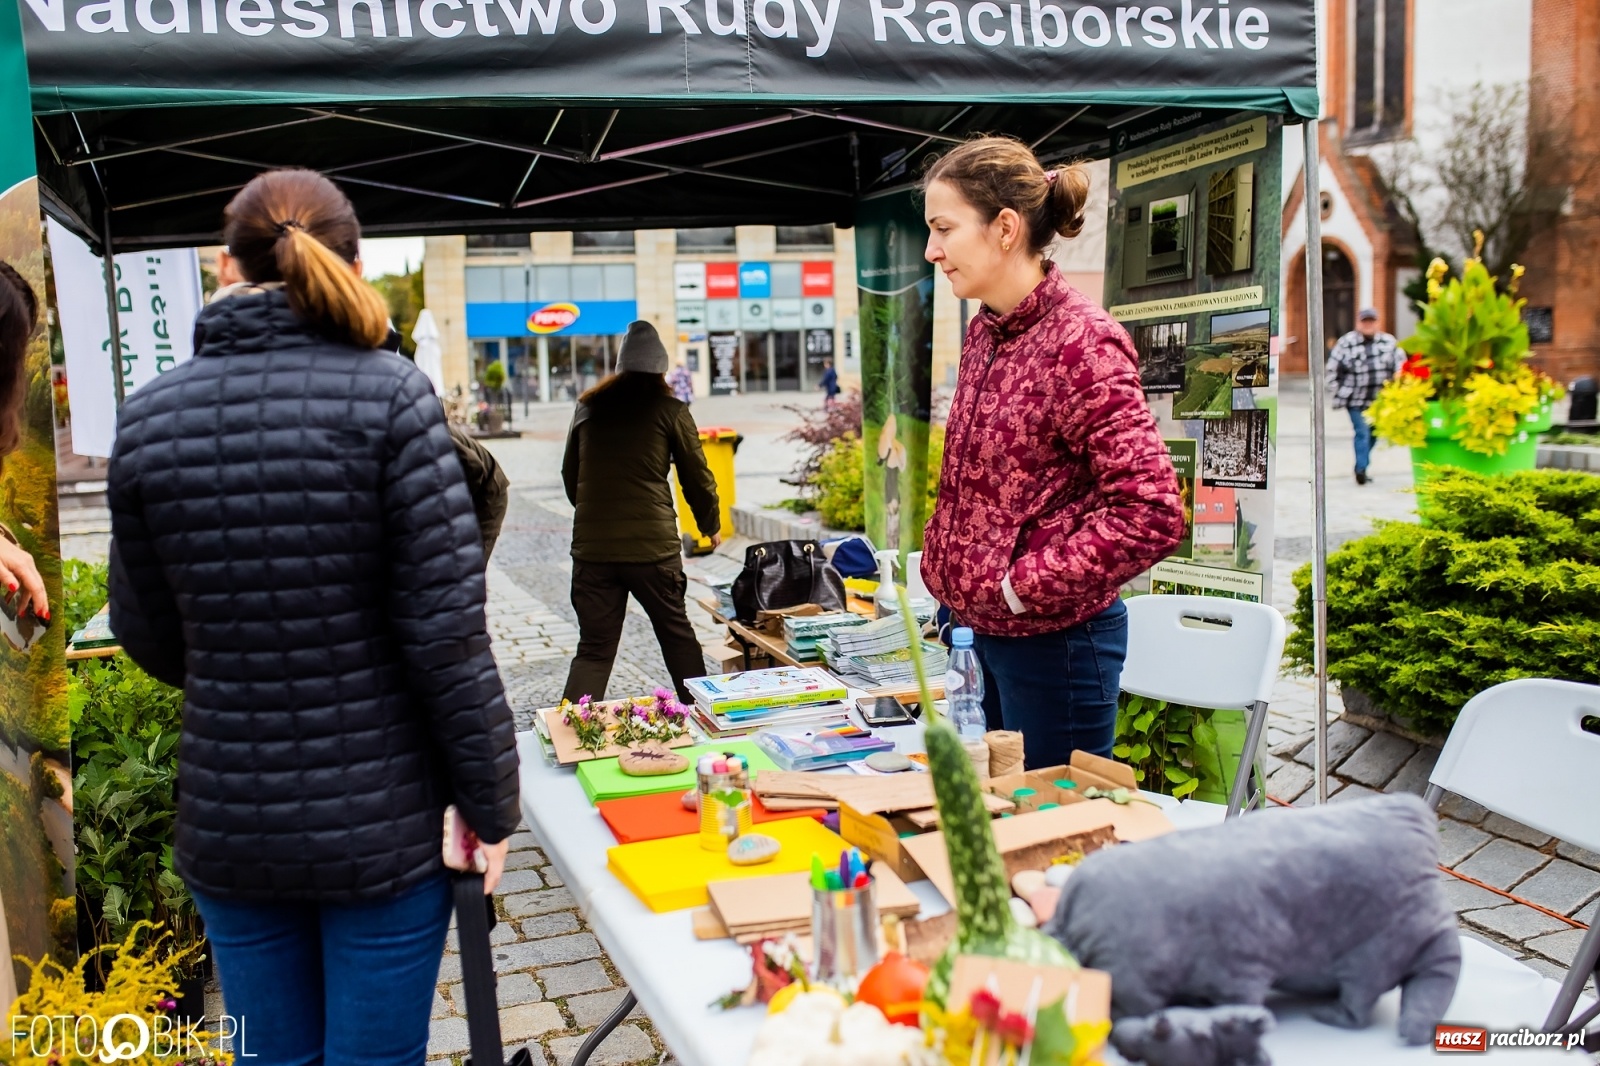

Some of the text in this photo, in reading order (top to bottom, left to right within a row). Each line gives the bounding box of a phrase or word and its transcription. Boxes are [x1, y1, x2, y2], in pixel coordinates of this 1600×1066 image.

[647, 0, 841, 57] Rudy
[869, 0, 1270, 50] Raciborskie
[1159, 121, 1173, 132] Rudy
[1173, 112, 1202, 126] Raciborskie
[1127, 158, 1149, 171] Produkcja
[1150, 148, 1181, 163] biopreparatu
[1185, 133, 1229, 153] zmikoryzowanych
[1229, 124, 1255, 139] sadzonek
[1136, 166, 1160, 179] technologii
[1161, 155, 1188, 171] stworzonej
[1188, 155, 1197, 163] dla
[1197, 148, 1213, 160] Lasów
[1214, 137, 1249, 155] Państwowych
[1112, 291, 1258, 318] OBSZARY ZASTOSOWANIA ZMIKORYZOWANYCH SADZONEK
[1170, 455, 1191, 463] ORFOWY
